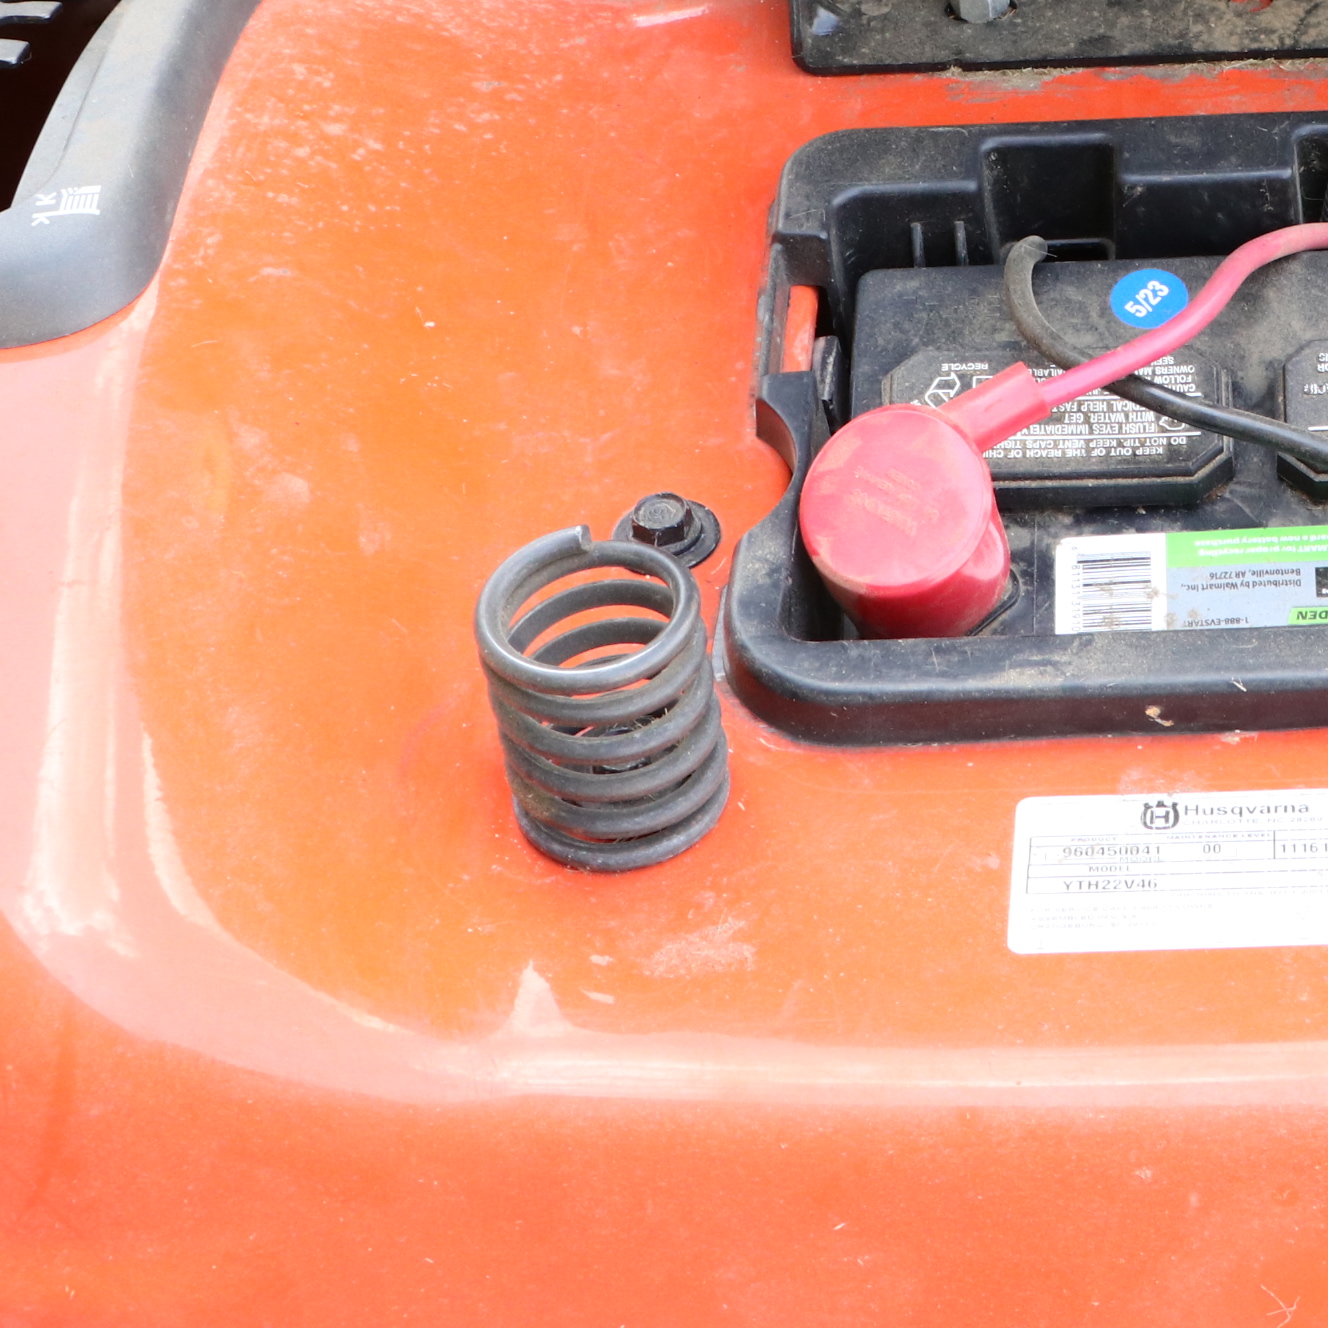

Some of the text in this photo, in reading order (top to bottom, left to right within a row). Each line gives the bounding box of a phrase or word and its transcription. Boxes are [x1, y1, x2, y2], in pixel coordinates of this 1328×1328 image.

[1124, 281, 1169, 317] 5/23
[941, 362, 989, 370] RECYCLE
[1155, 365, 1195, 375] OWNERS
[1154, 375, 1192, 384] FOLLOW
[1081, 401, 1107, 412] HELP
[1064, 412, 1155, 424] WITH WATER. GET
[1020, 423, 1155, 435] FLUSH EYES IMMEDIATELY
[1026, 440, 1054, 448] CAPS
[1089, 439, 1117, 448] KEEP
[1120, 438, 1140, 447] TIP.
[1146, 437, 1167, 446] NOT
[1171, 436, 1187, 445] DO
[1007, 449, 1023, 458] OF
[1026, 449, 1061, 458] REACH
[1065, 448, 1086, 457] THE
[1091, 448, 1106, 456] OF
[1110, 447, 1132, 456] OUT
[1135, 447, 1163, 455] KEEP
[1194, 537, 1241, 547] purchase
[1241, 536, 1279, 545] battery
[1198, 547, 1244, 557] recycling
[1245, 544, 1280, 554] proper
[1281, 545, 1296, 553] for
[1209, 568, 1301, 580] Bentonville, AR 72716
[1181, 579, 1302, 592] Distributed by Walmart Inc.,
[1182, 616, 1249, 627] 1-888-EVSTART
[1184, 803, 1310, 817] Husqvarna
[1062, 845, 1161, 858] 960450041
[1202, 843, 1222, 854] 00
[1088, 865, 1132, 873] MODEL
[1063, 879, 1159, 891] YTH22V46
